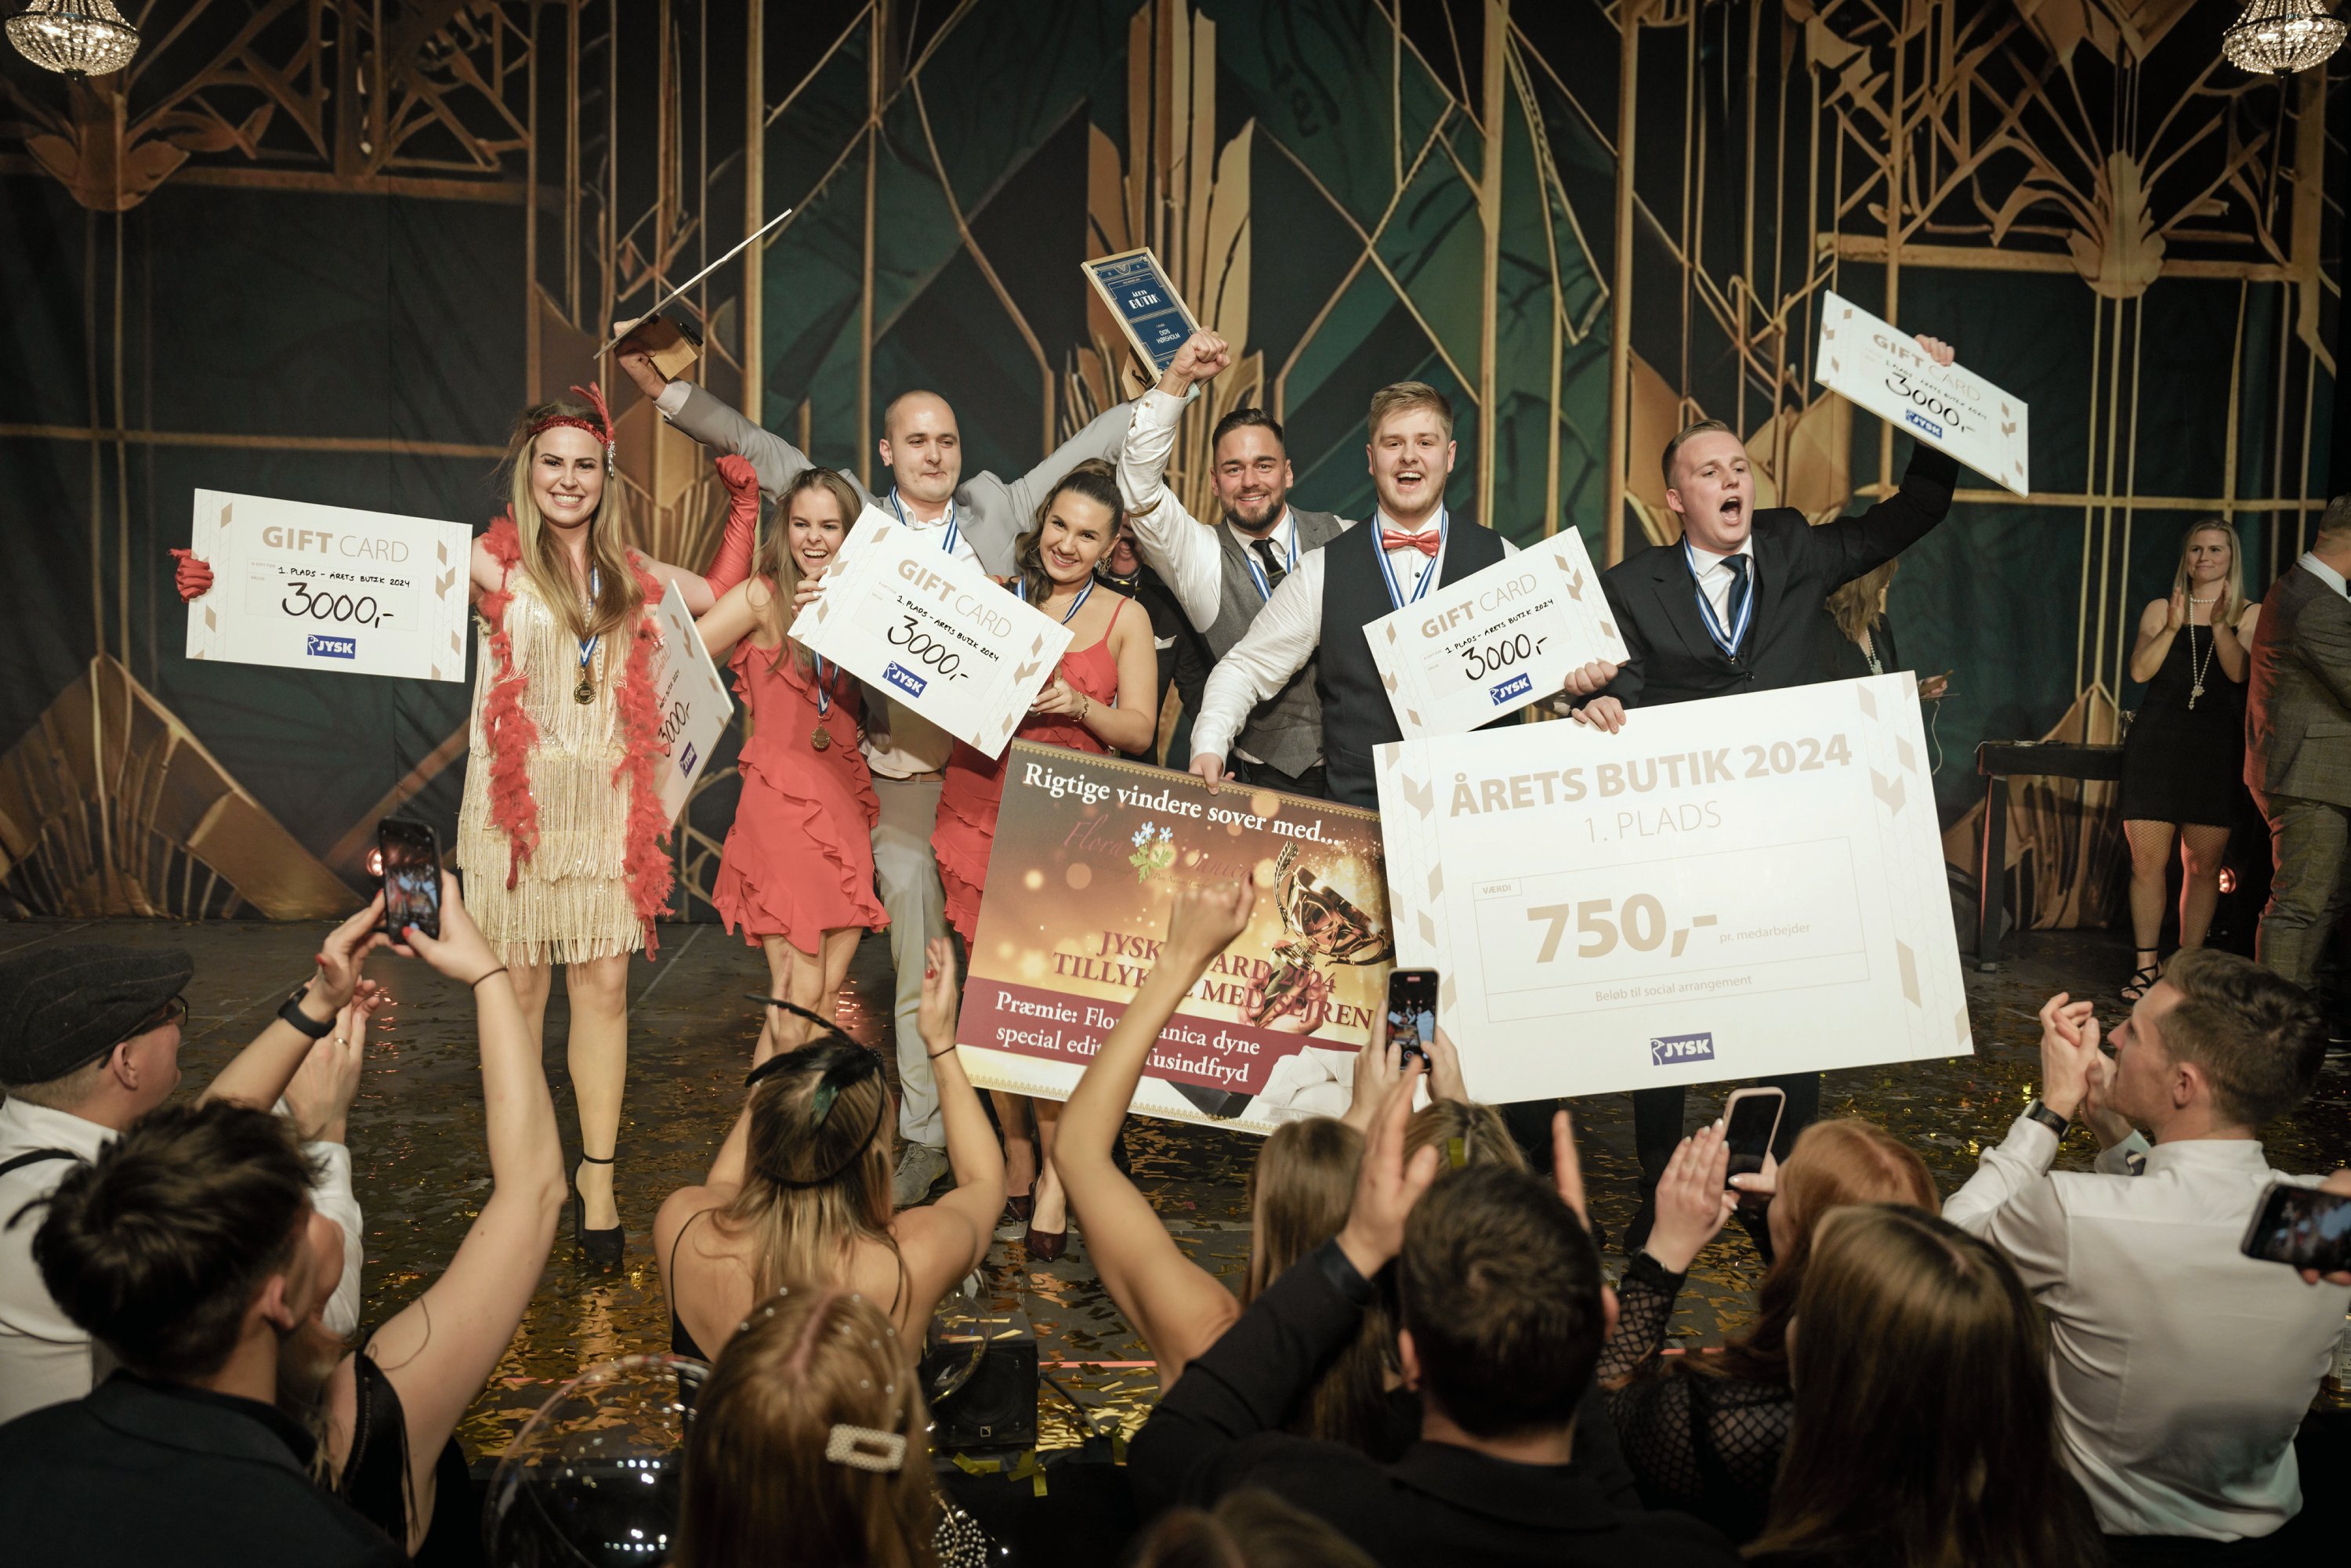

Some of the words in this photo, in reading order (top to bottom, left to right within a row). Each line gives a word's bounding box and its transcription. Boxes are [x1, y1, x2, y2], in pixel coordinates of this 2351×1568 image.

[1128, 294, 1161, 309] BUTIK
[1874, 335, 1924, 368] GIFT
[1929, 365, 1980, 400] CARD
[1886, 371, 1976, 433] 3000,-
[1913, 415, 1941, 436] JYSK
[263, 527, 333, 553] GIFT
[340, 535, 408, 562] CARD
[291, 568, 316, 577] PLADS
[282, 582, 393, 628] 3000,-
[898, 559, 957, 602] GIFT
[955, 595, 1011, 637] CARD
[1422, 600, 1473, 638] GIFT
[1480, 574, 1536, 611] CARD
[317, 640, 353, 654] JYSK
[897, 596, 904, 605] 1.
[906, 600, 928, 617] PLADS
[957, 632, 978, 649] BUTIK
[980, 647, 999, 661] 2024
[1454, 636, 1476, 649] PLADS
[1509, 610, 1531, 624] BUTIK
[1535, 599, 1553, 611] 2024
[888, 615, 969, 681] 3000,-
[1462, 634, 1548, 680] 3000,-
[892, 670, 924, 693] JYSK
[1500, 677, 1529, 697] JYSK
[1450, 767, 1587, 817] ÅRETS
[1596, 748, 1735, 798] BUTIK
[1742, 733, 1853, 778] 2024
[1022, 762, 1110, 804] Rigtige
[1117, 784, 1201, 818] vindere
[1207, 806, 1267, 831] sover
[1271, 820, 1339, 846] med...
[1585, 817, 1608, 842] 1.
[1617, 801, 1721, 839] PLADS
[1483, 885, 1512, 894] VÆRDI
[1527, 893, 1718, 964] 750,-
[1719, 933, 1734, 944] pr.
[1737, 923, 1810, 941] medarbejder
[1096, 930, 1167, 961] JYSK
[1210, 952, 1273, 980] ARD
[1279, 965, 1336, 994] 2024
[1200, 979, 1266, 1009] MED
[1273, 993, 1374, 1030] SEJREN
[1596, 987, 1628, 1002] Beløb
[1631, 985, 1641, 998] til
[1644, 983, 1675, 997] social
[1678, 975, 1752, 992] arrangement
[995, 990, 1078, 1023] Præmie:
[1158, 1025, 1206, 1046] anica
[1213, 1030, 1260, 1056] dyne
[996, 1027, 1061, 1050] special
[1665, 1038, 1712, 1057] JYSK
